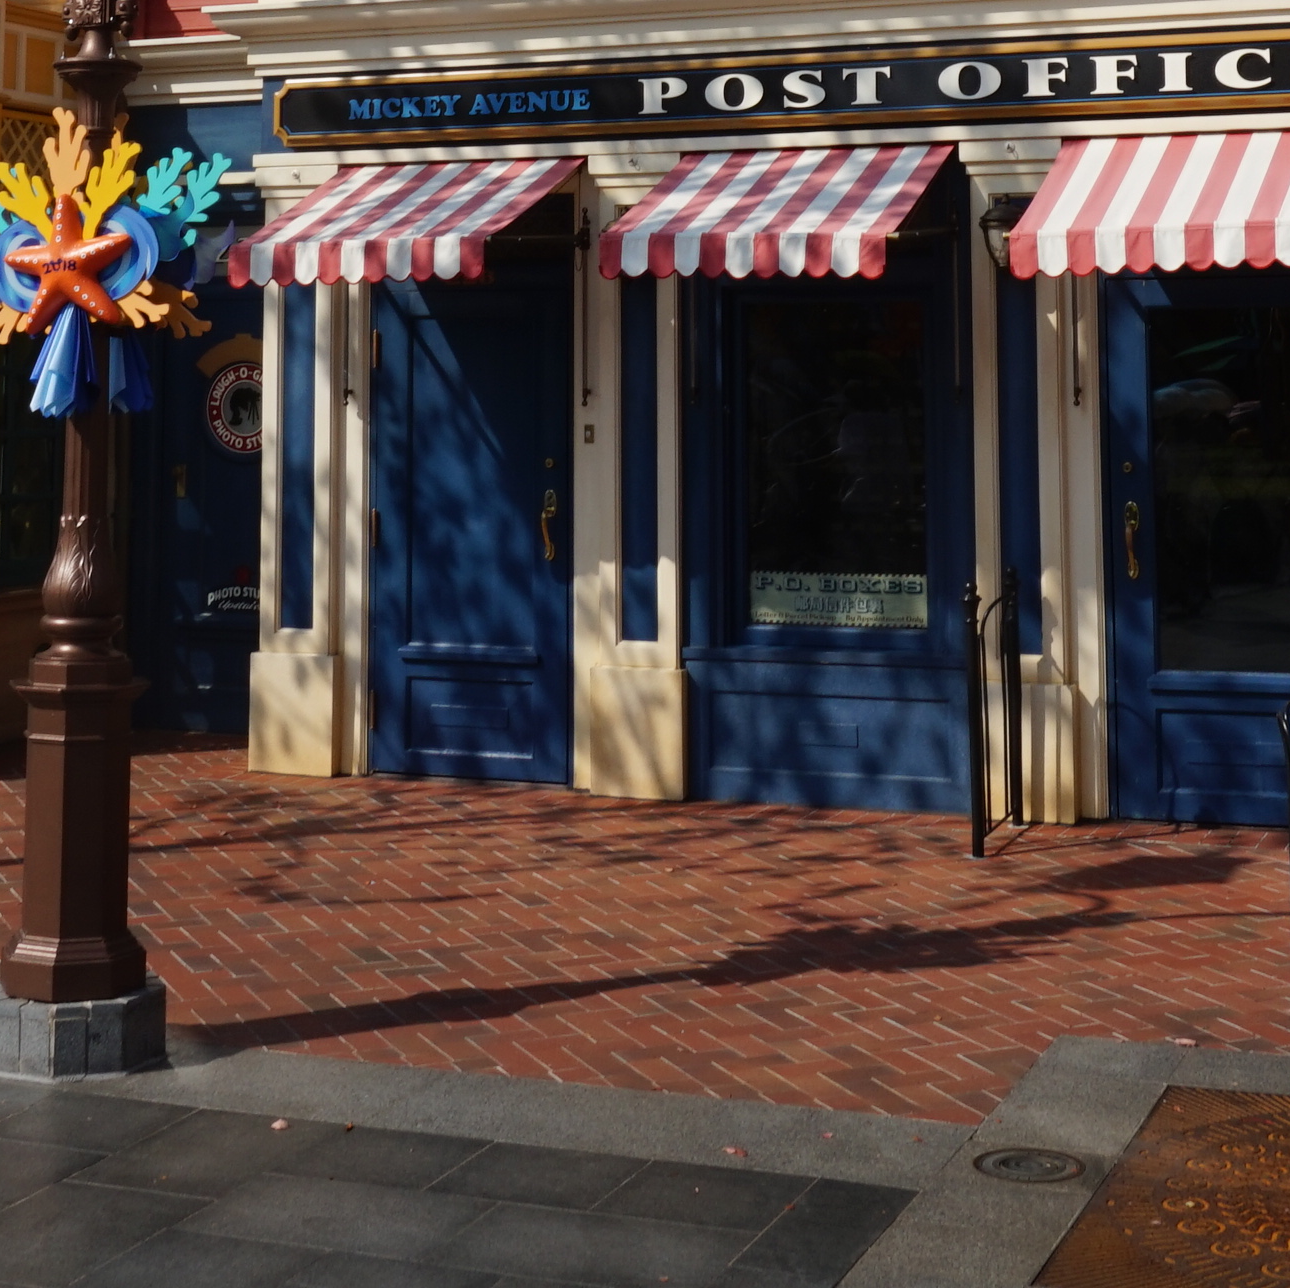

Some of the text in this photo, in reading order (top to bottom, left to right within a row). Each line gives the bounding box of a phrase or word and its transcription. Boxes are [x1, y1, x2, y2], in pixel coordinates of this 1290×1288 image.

[348, 93, 462, 120] MICKEY
[469, 88, 591, 115] AVENUE
[637, 65, 891, 115] POST
[42, 258, 77, 274] 2018
[213, 419, 244, 448] PHOTO
[755, 576, 923, 594] P.O. BOXES
[207, 586, 241, 606] PHOTO
